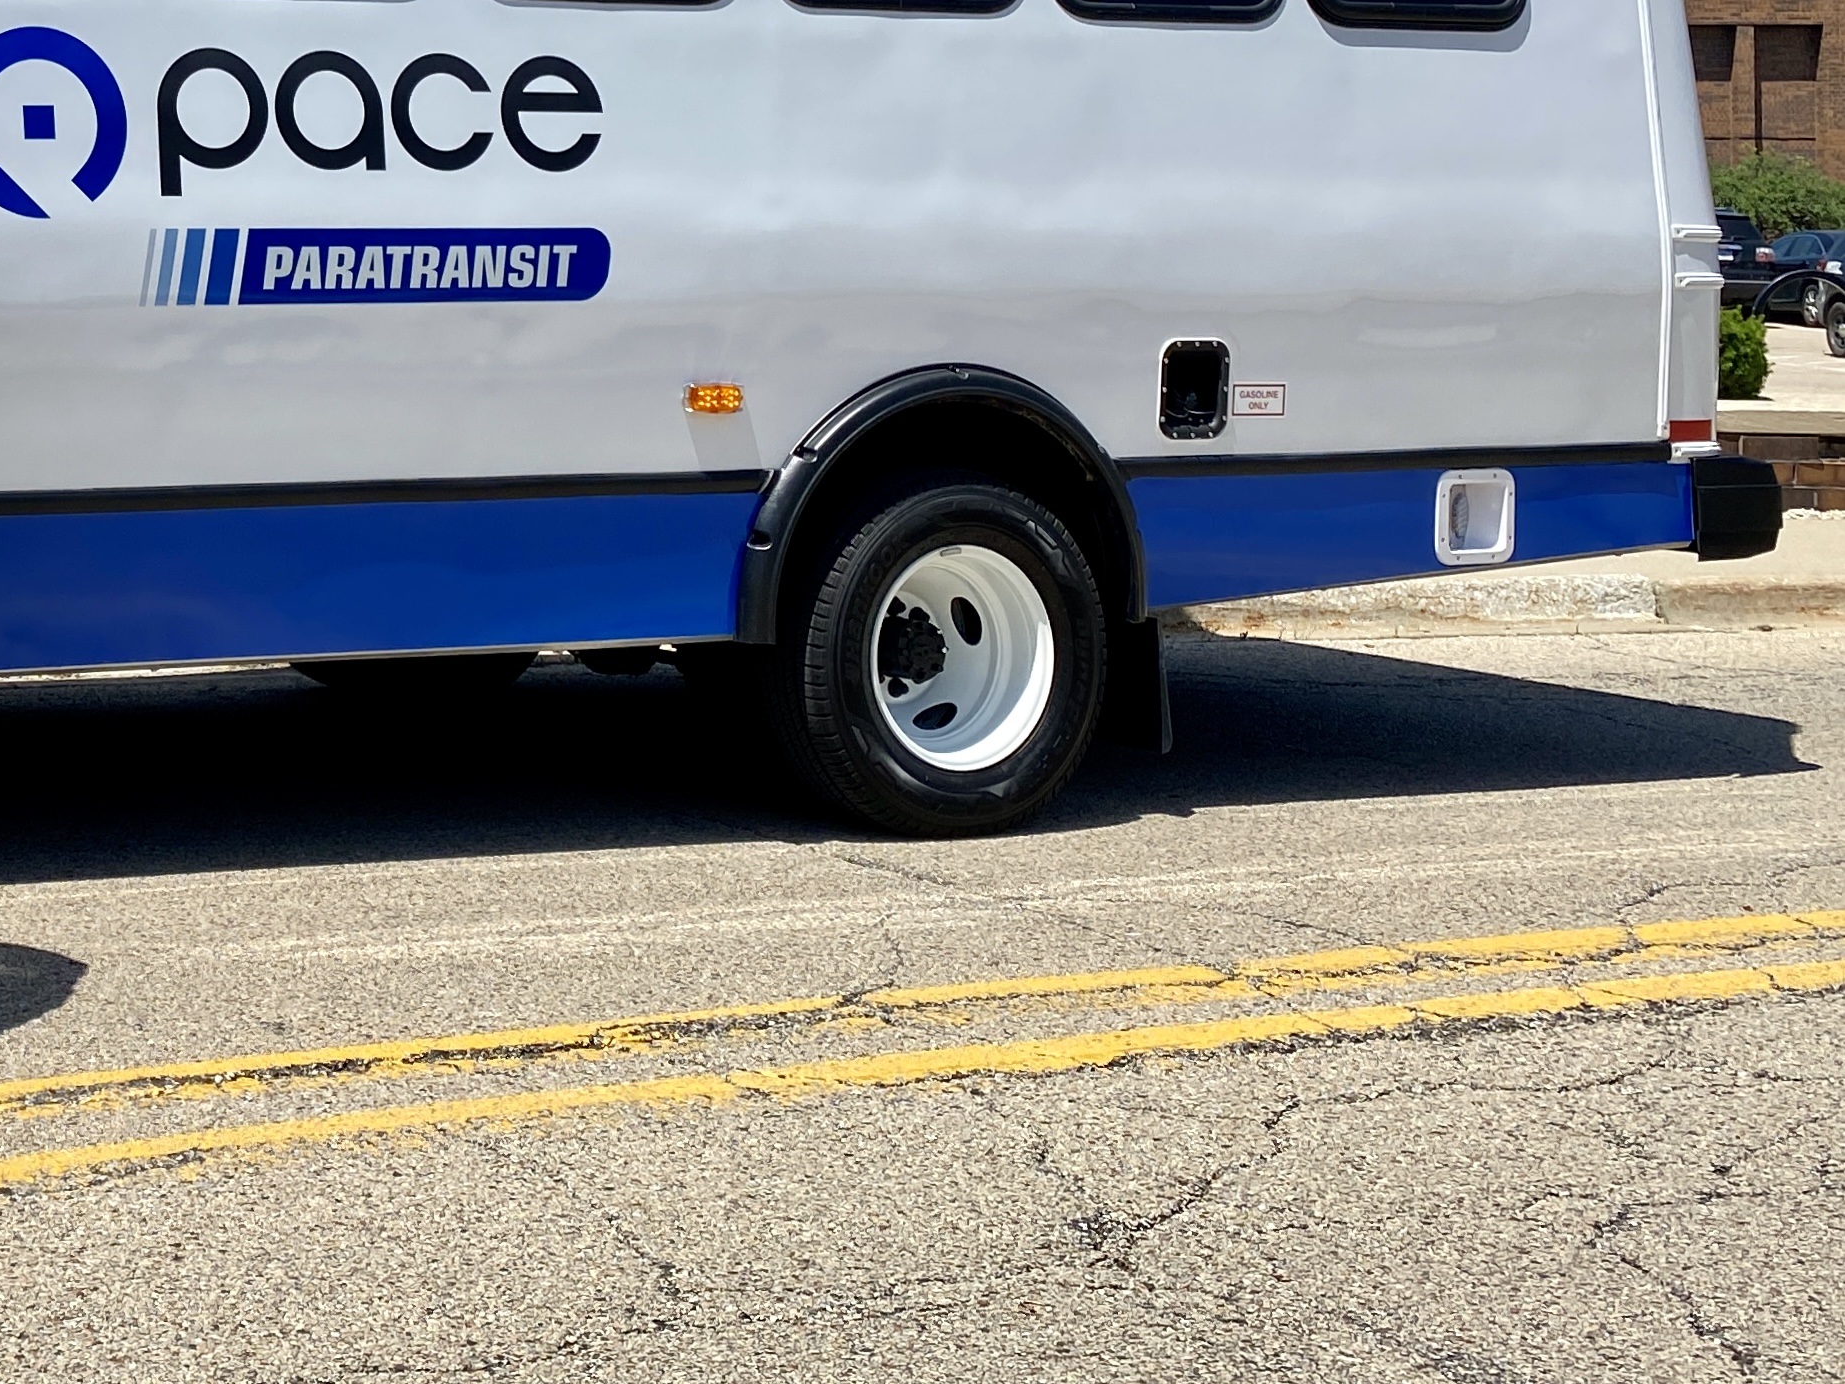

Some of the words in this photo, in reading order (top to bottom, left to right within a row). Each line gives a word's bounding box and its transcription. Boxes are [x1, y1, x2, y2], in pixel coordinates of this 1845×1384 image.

[157, 47, 603, 197] pace
[262, 244, 577, 291] PARATRANSIT
[1239, 390, 1279, 399] GASOLINE
[1248, 402, 1269, 410] ONLY
